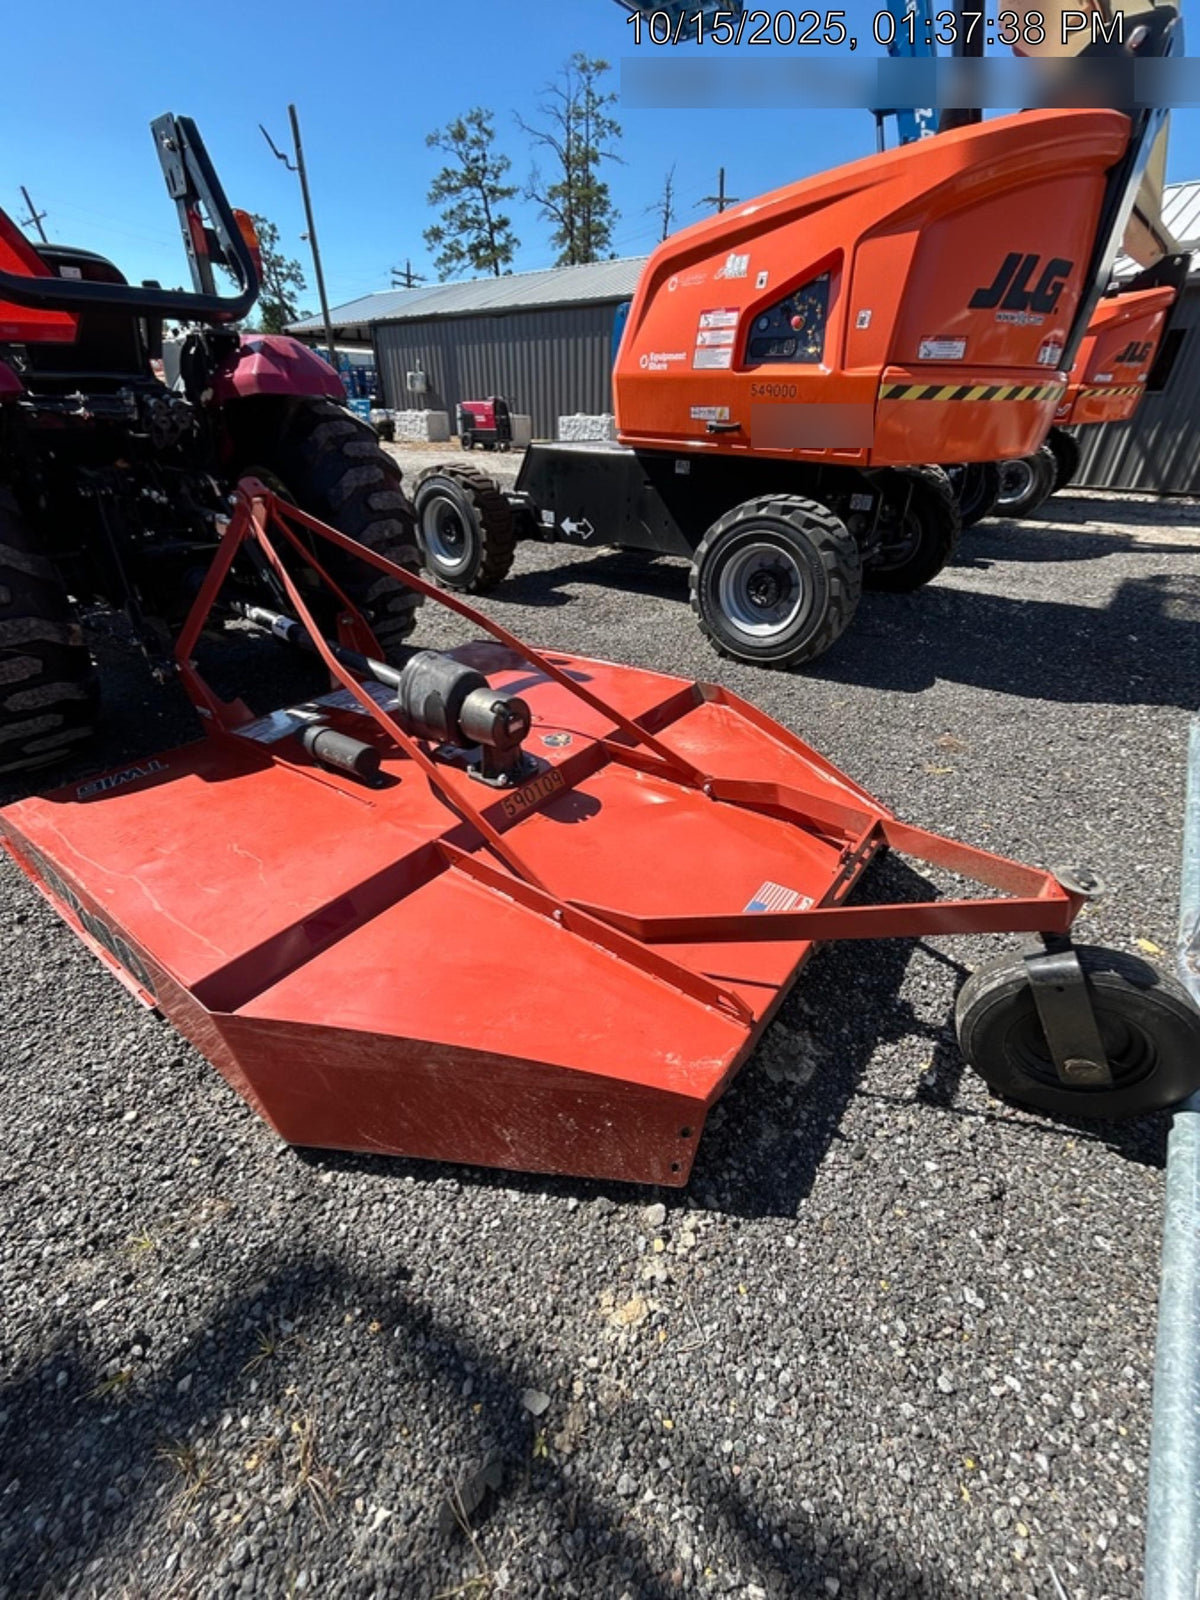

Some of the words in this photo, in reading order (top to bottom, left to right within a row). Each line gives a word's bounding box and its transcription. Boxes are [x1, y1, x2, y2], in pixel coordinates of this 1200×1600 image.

[968, 252, 1074, 314] JLG
[1114, 342, 1154, 363] JLG
[750, 383, 798, 398] 549000
[503, 768, 562, 816] 590109
